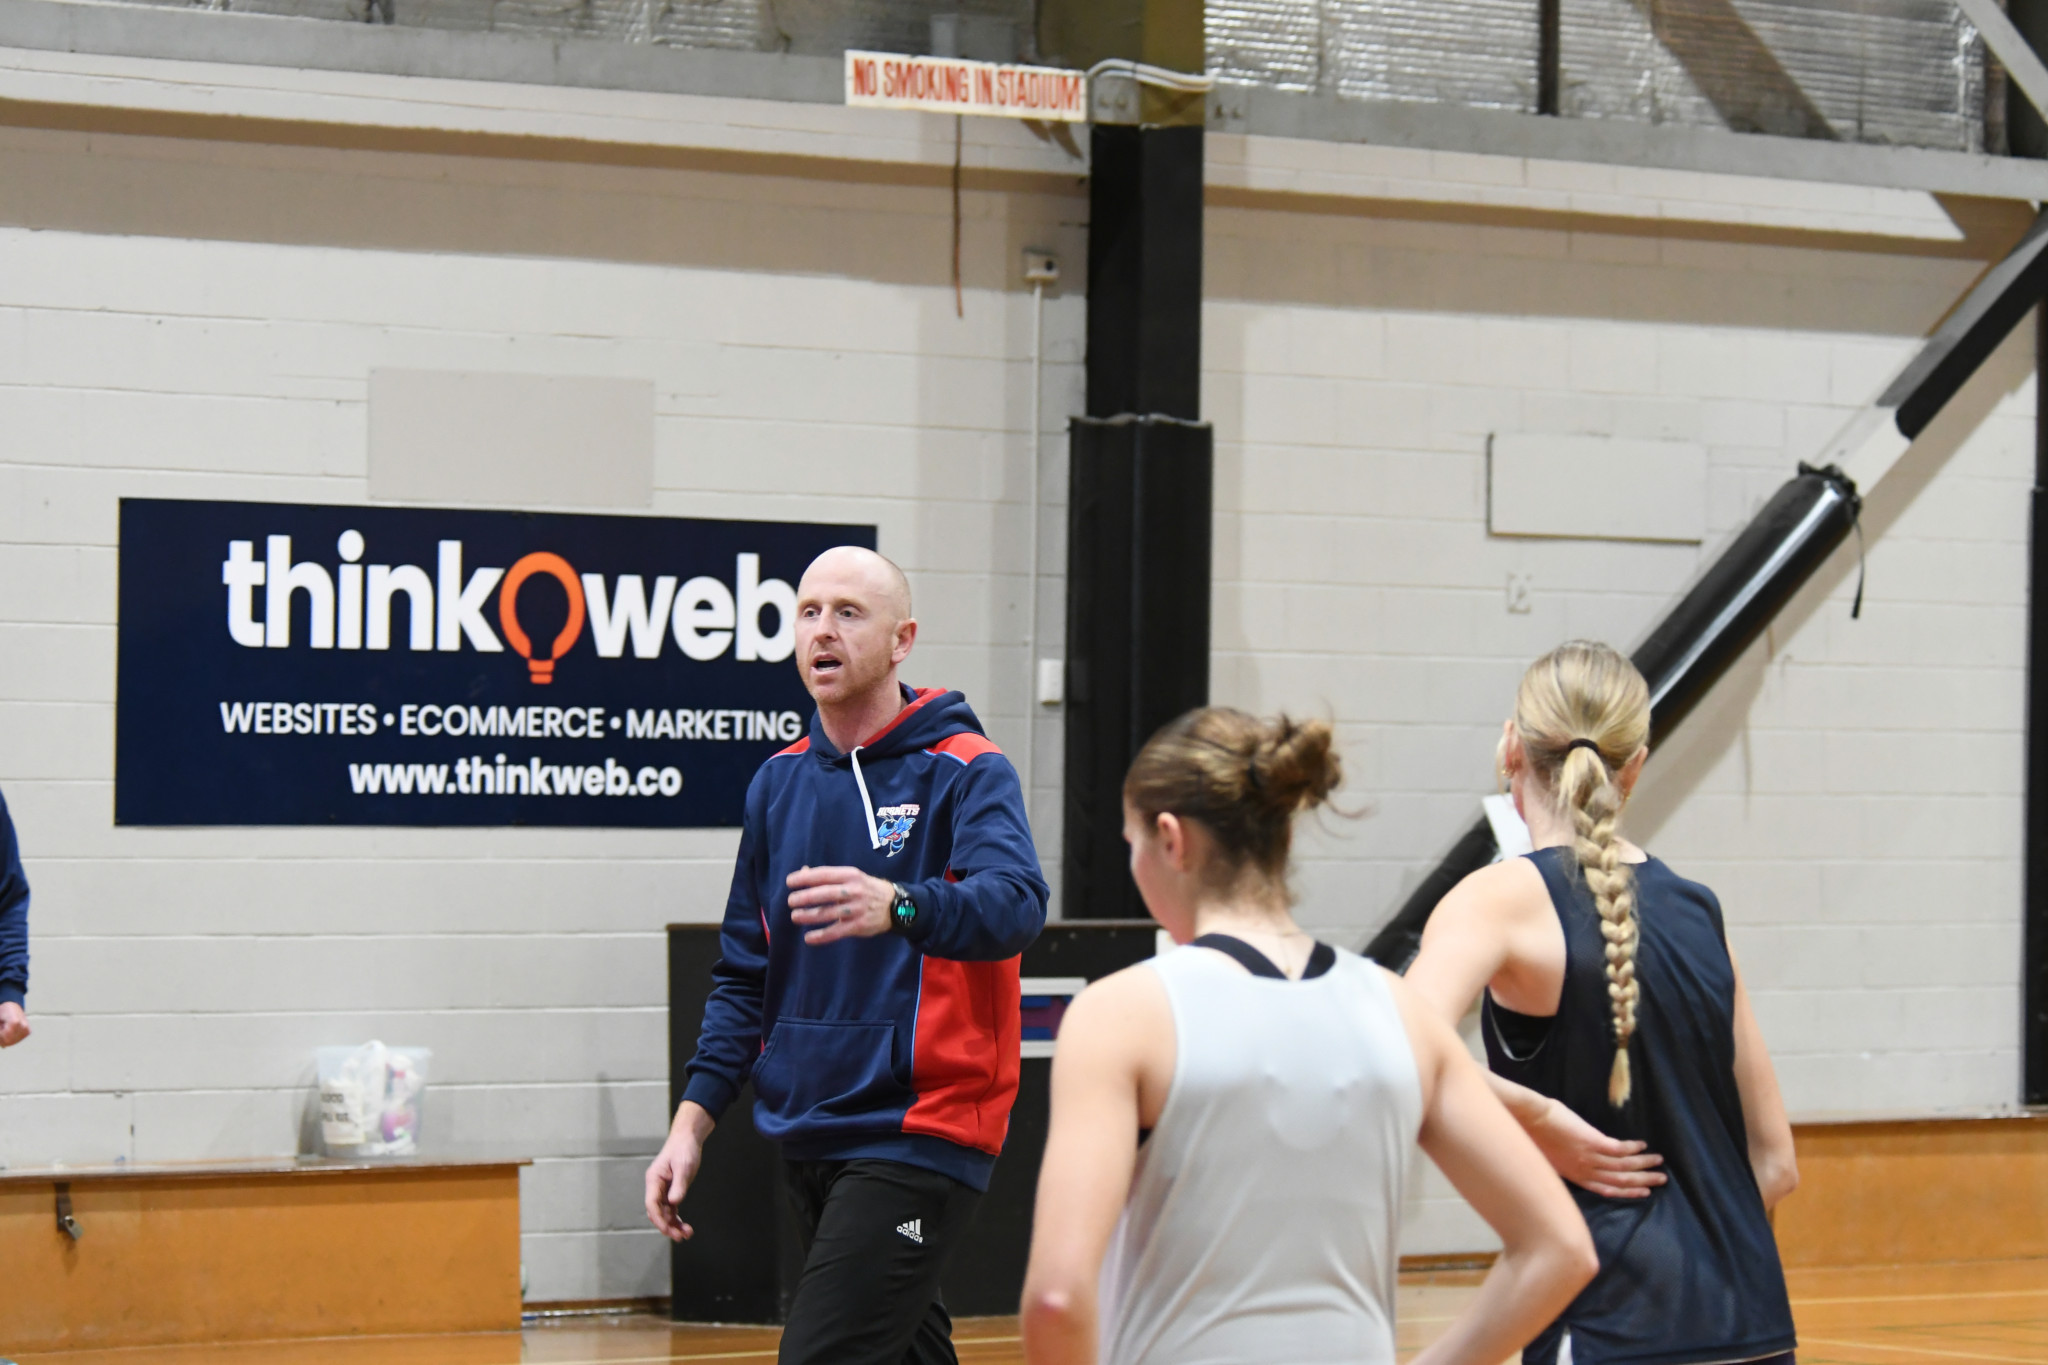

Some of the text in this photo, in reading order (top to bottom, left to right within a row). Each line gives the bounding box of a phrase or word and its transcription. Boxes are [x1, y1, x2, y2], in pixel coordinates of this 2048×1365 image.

[854, 59, 1080, 110] NO SMOKING IN STADIUM
[219, 702, 802, 741] WEBSITES ECOMMERCE MARKETING
[348, 753, 682, 797] www.thinkweb.co
[896, 1225, 924, 1243] adidas
